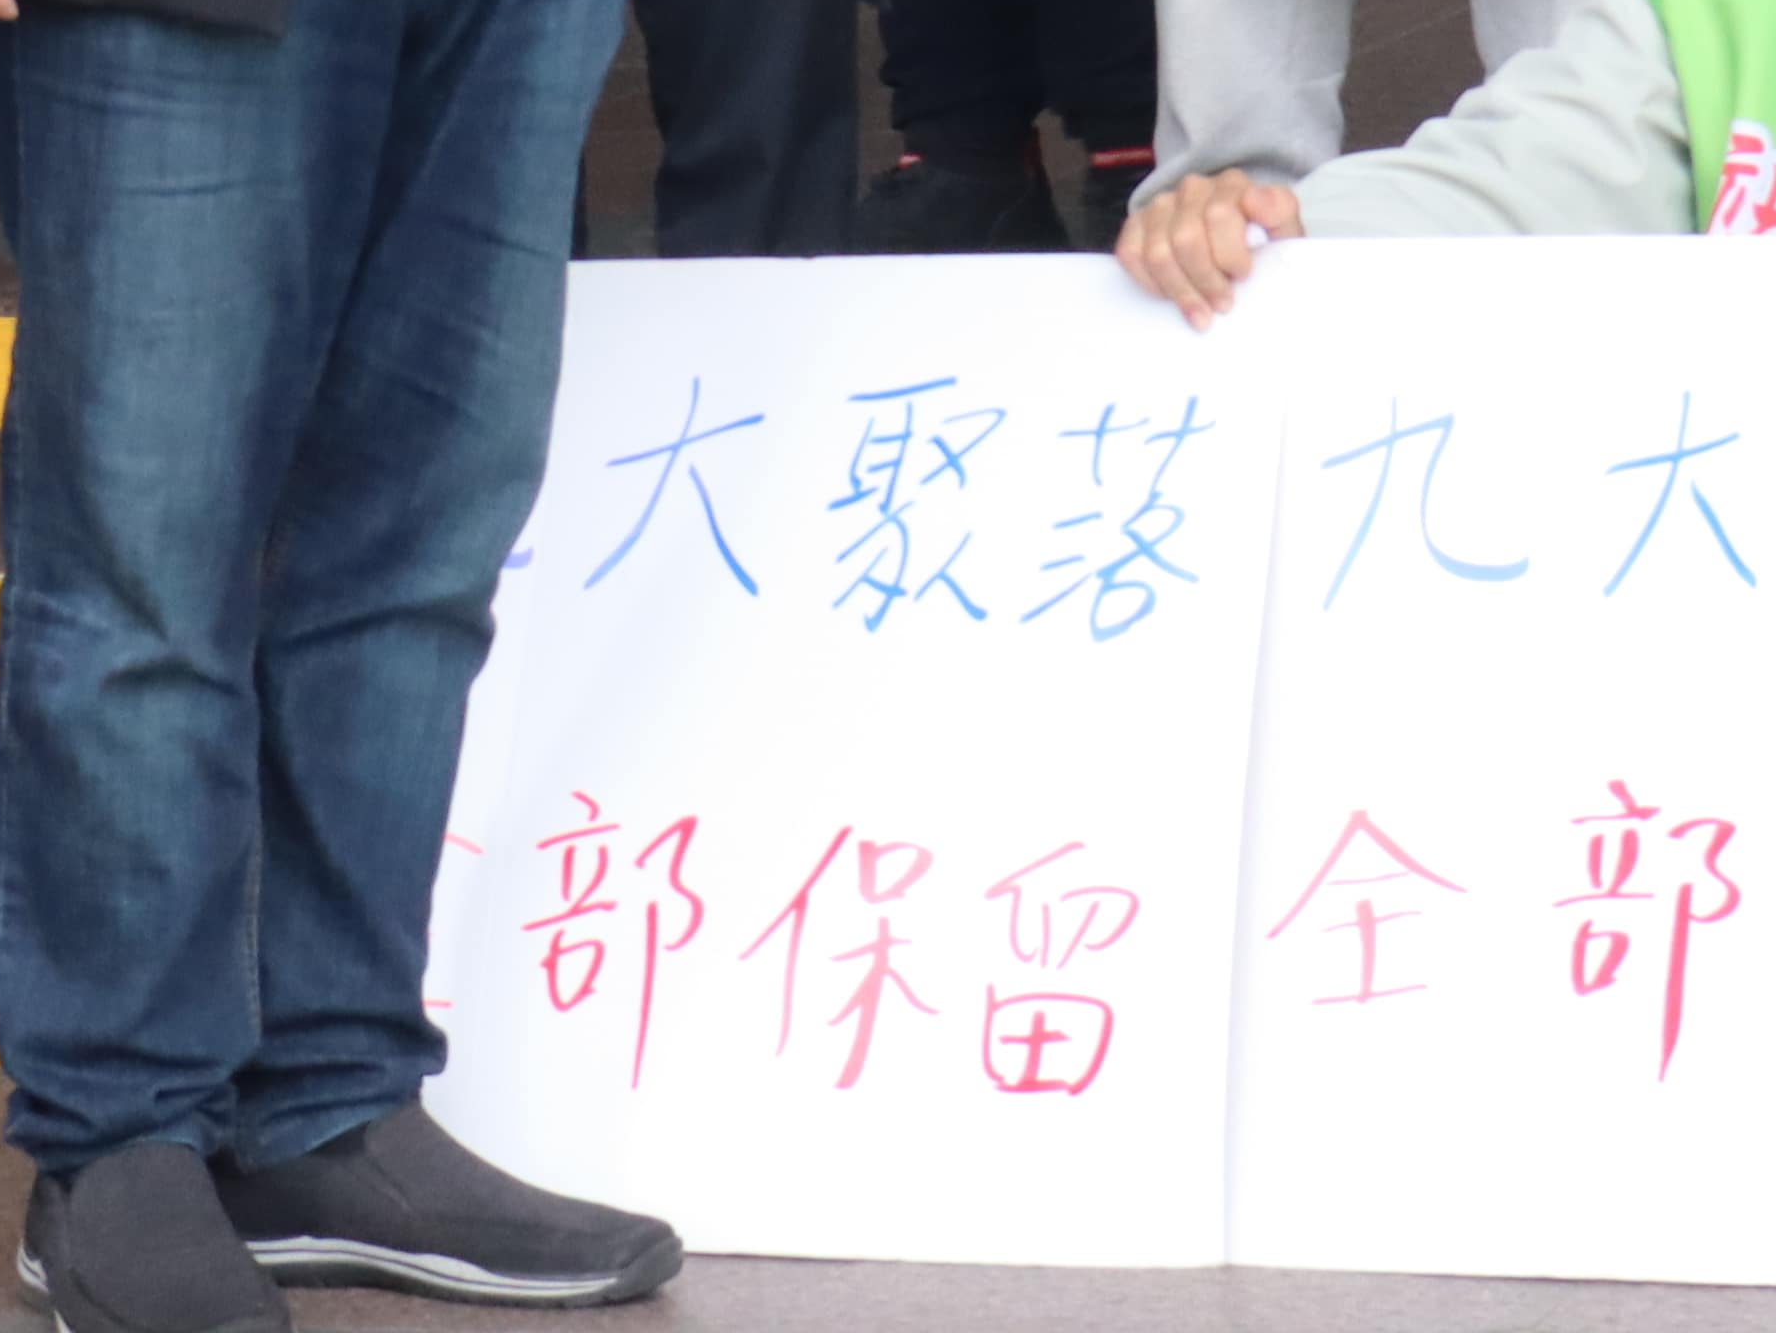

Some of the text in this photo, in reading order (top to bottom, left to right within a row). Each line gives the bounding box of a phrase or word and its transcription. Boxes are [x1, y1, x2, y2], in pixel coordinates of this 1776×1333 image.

[499, 375, 1216, 643] 大聚落
[424, 789, 1141, 1097] 部保留
